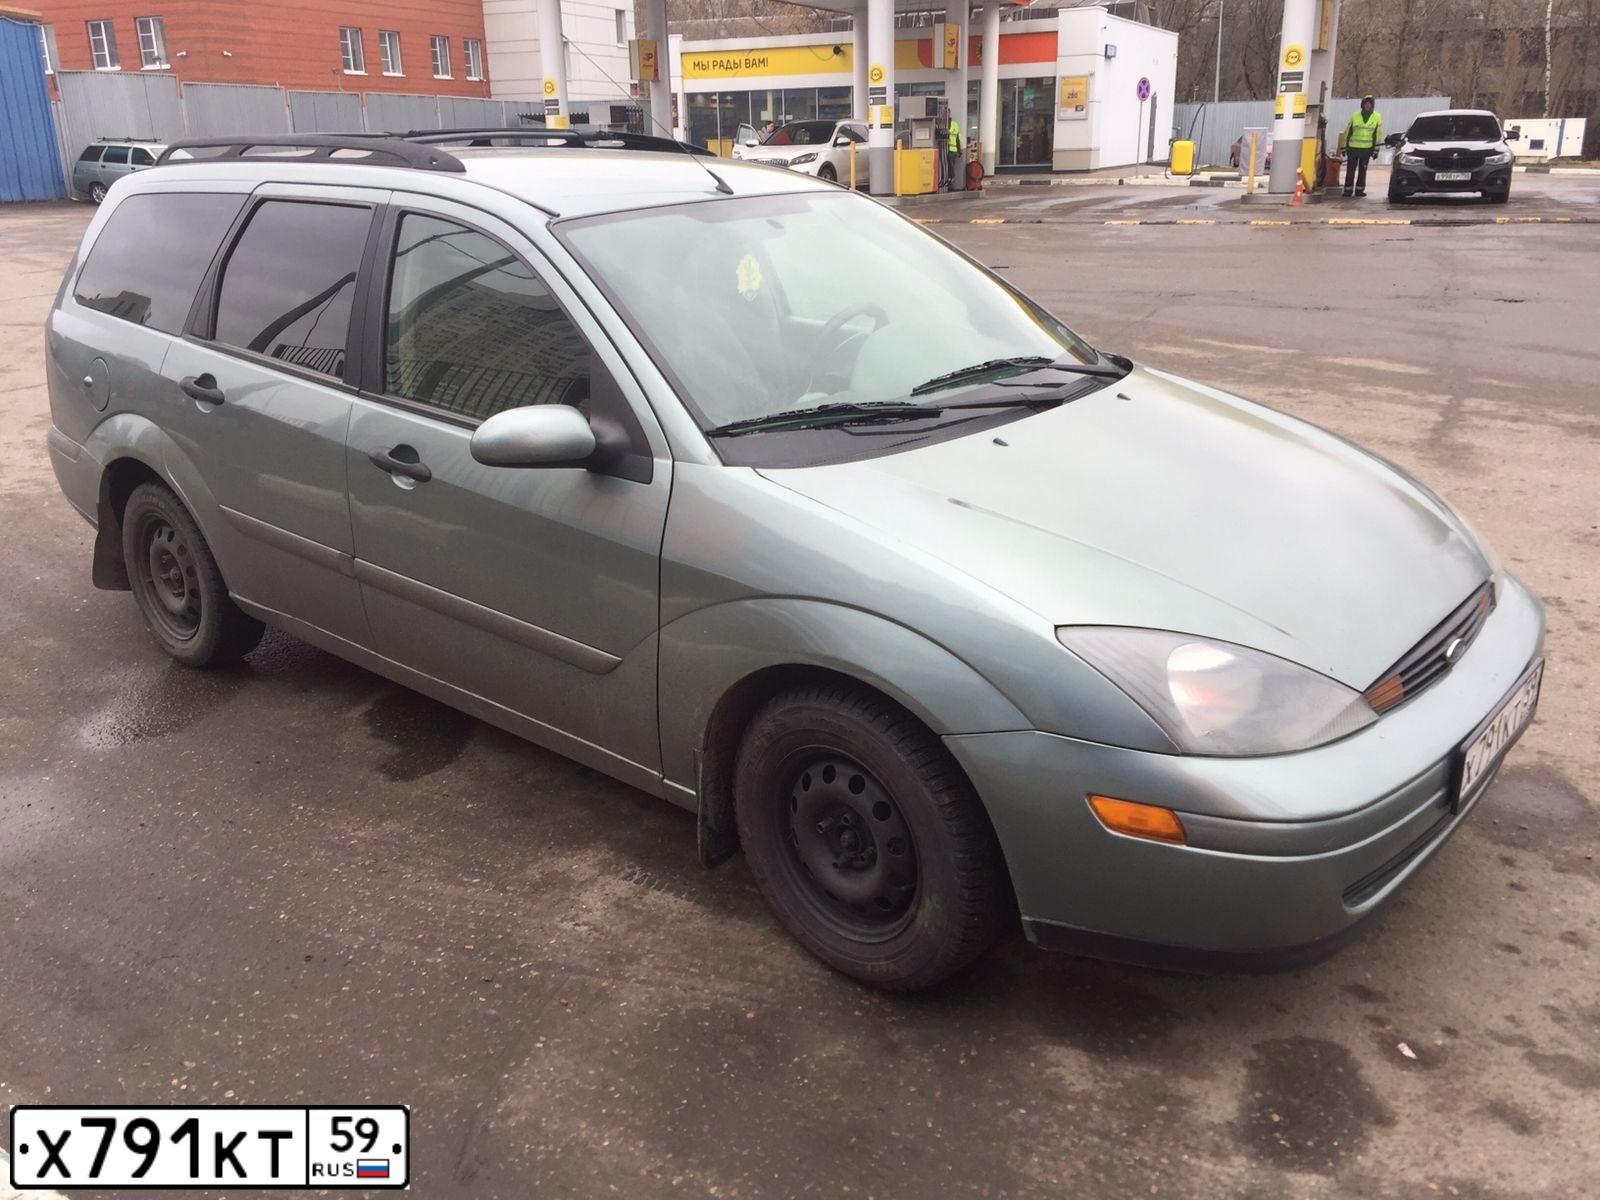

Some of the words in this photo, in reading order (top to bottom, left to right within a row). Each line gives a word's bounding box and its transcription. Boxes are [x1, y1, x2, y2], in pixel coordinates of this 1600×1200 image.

[693, 61, 710, 71] МЫ
[712, 59, 742, 71] РАДЫ
[744, 57, 769, 69] ВАМ!
